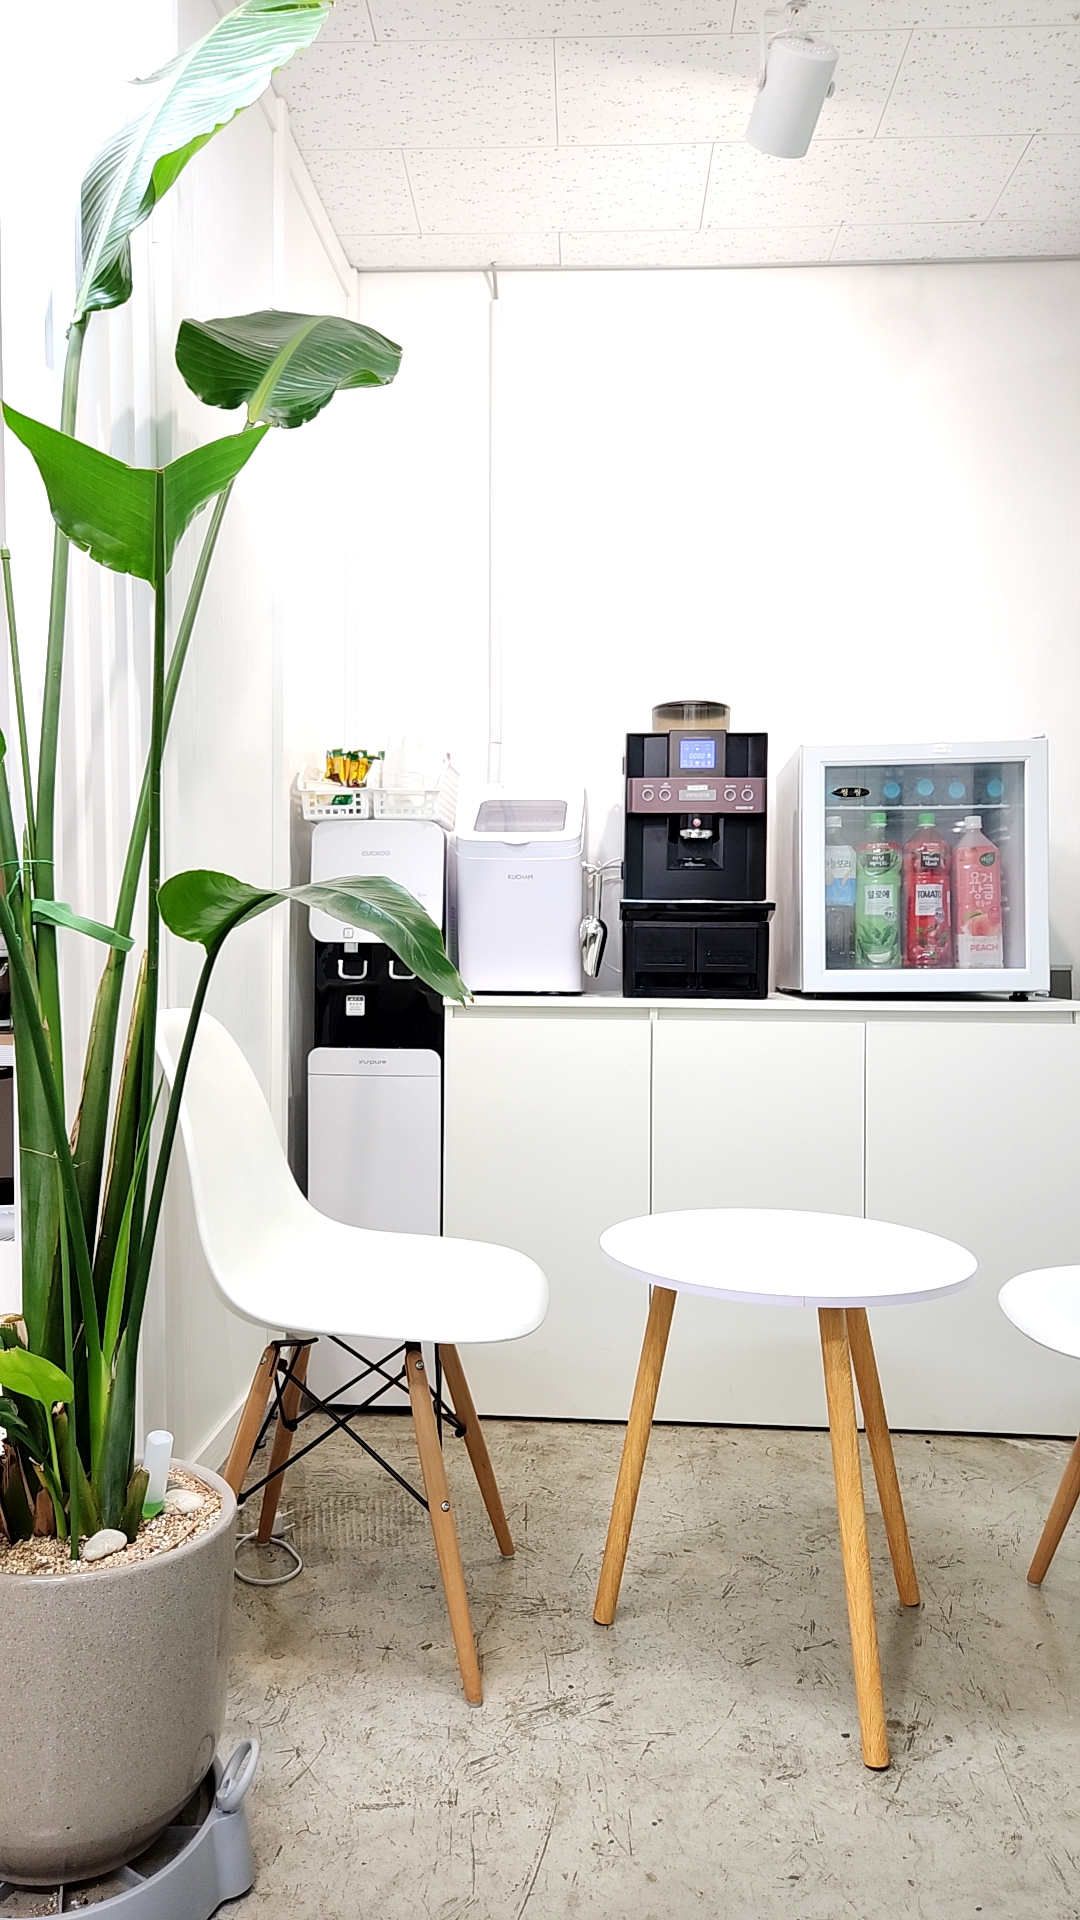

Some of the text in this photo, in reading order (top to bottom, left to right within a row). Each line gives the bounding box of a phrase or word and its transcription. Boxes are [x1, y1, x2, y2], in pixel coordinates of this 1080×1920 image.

[969, 871, 993, 885] 요거
[867, 890, 890, 899] 알로에
[917, 890, 942, 899] TOMATO
[969, 884, 995, 900] 상큼
